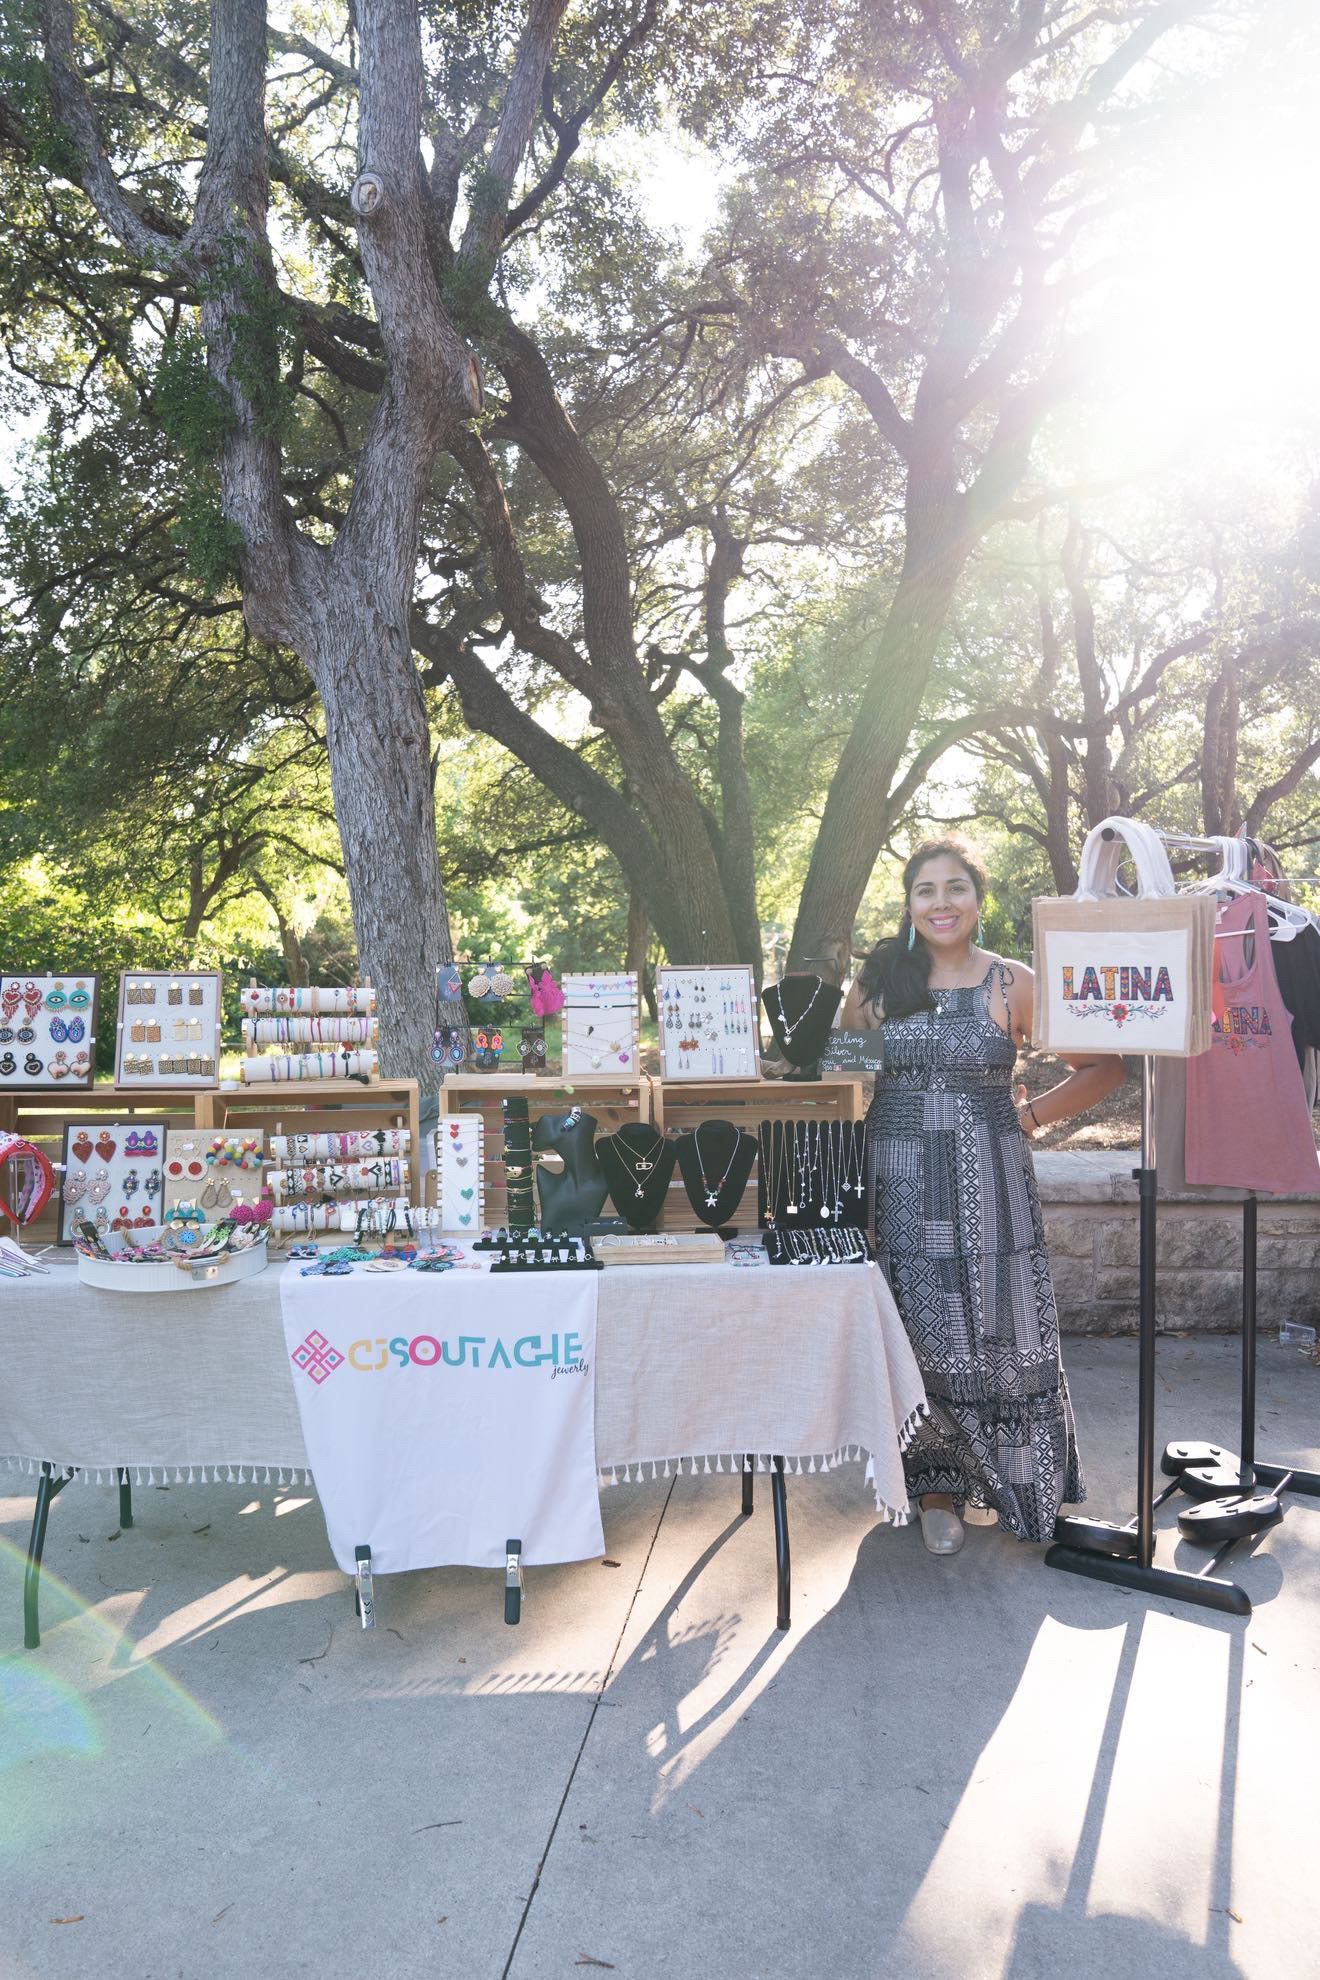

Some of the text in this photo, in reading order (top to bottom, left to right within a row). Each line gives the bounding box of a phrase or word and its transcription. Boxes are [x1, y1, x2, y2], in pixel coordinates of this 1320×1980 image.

[1062, 967, 1174, 1001] LATINA
[1211, 1006, 1272, 1036] TINA
[827, 1031, 867, 1048] terling
[824, 1045, 852, 1056] Silver
[551, 1358, 589, 1379] jewerly
